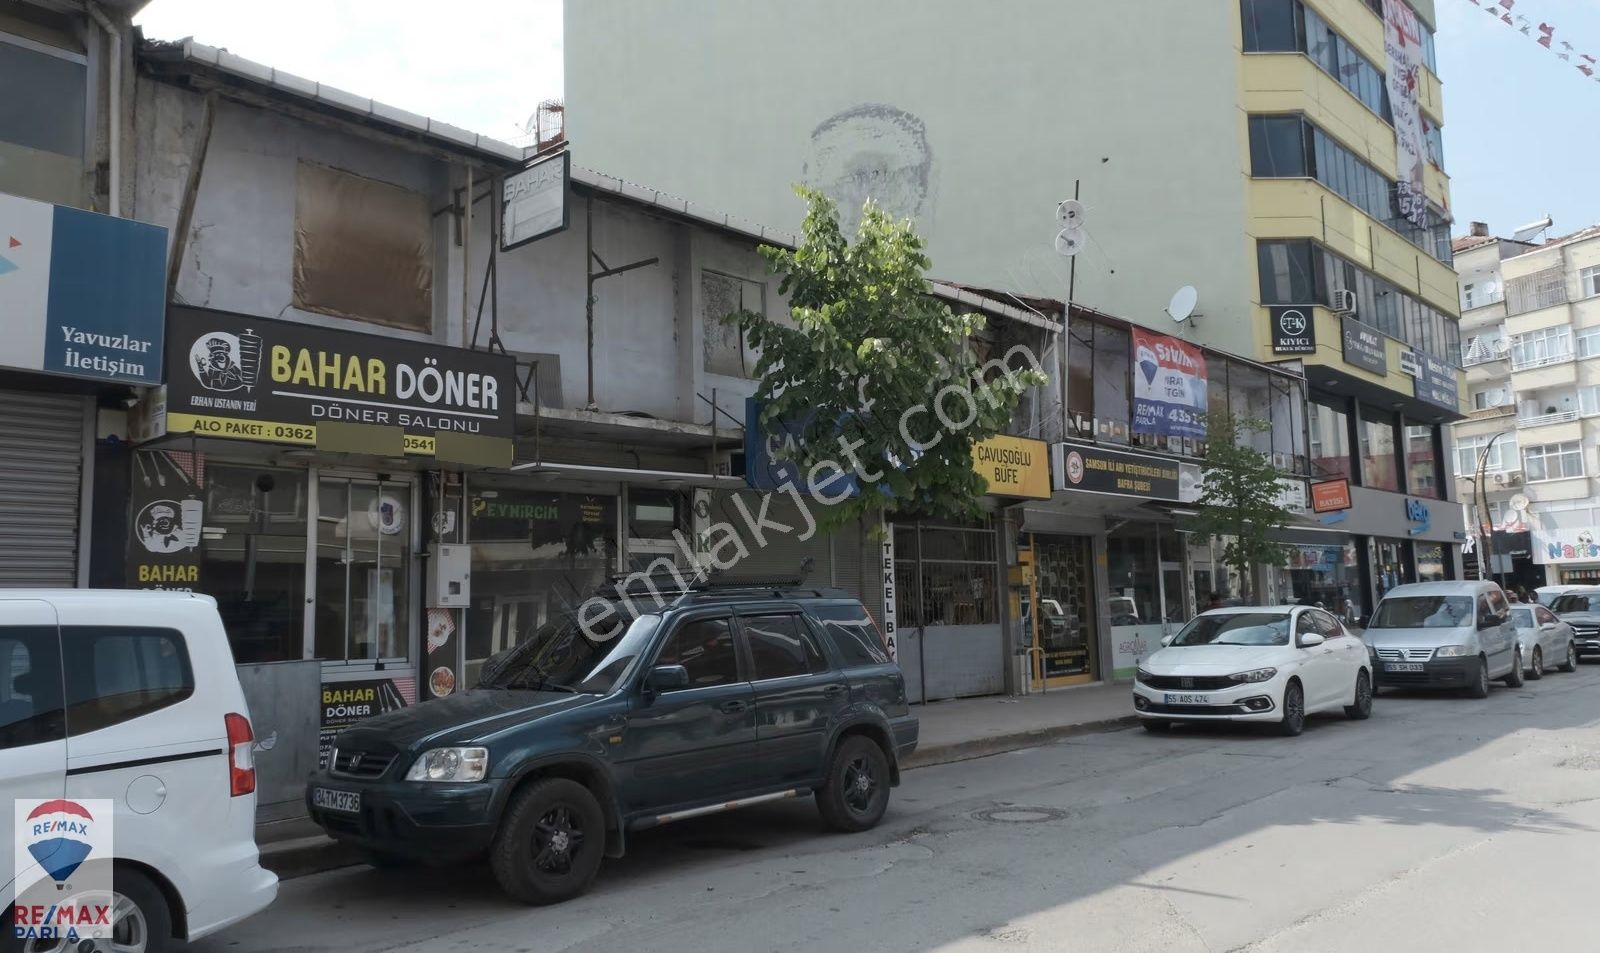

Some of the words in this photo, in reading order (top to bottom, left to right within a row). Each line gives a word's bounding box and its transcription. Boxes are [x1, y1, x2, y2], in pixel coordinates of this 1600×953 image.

[61, 325, 152, 353] Yavuzlar
[65, 348, 145, 376] İletişim
[271, 345, 386, 394] BAHAR
[395, 357, 498, 410] DÖNER
[191, 396, 212, 407] ERHAN
[243, 400, 257, 411] YERİ
[311, 403, 389, 423] DÖNER
[398, 414, 480, 433] SALONU
[193, 419, 221, 431] ALO
[225, 422, 264, 436] PAKET
[274, 426, 313, 440] 0362
[403, 438, 435, 450] 0541
[977, 445, 1032, 467] ÇAVUŞOĞLU
[994, 465, 1019, 484] BÜFE
[138, 565, 198, 582] BAHAR
[882, 543, 895, 614] TEKEL
[322, 688, 375, 704] BAHAR
[1168, 694, 1177, 703] 55
[326, 704, 371, 718] DÖNER
